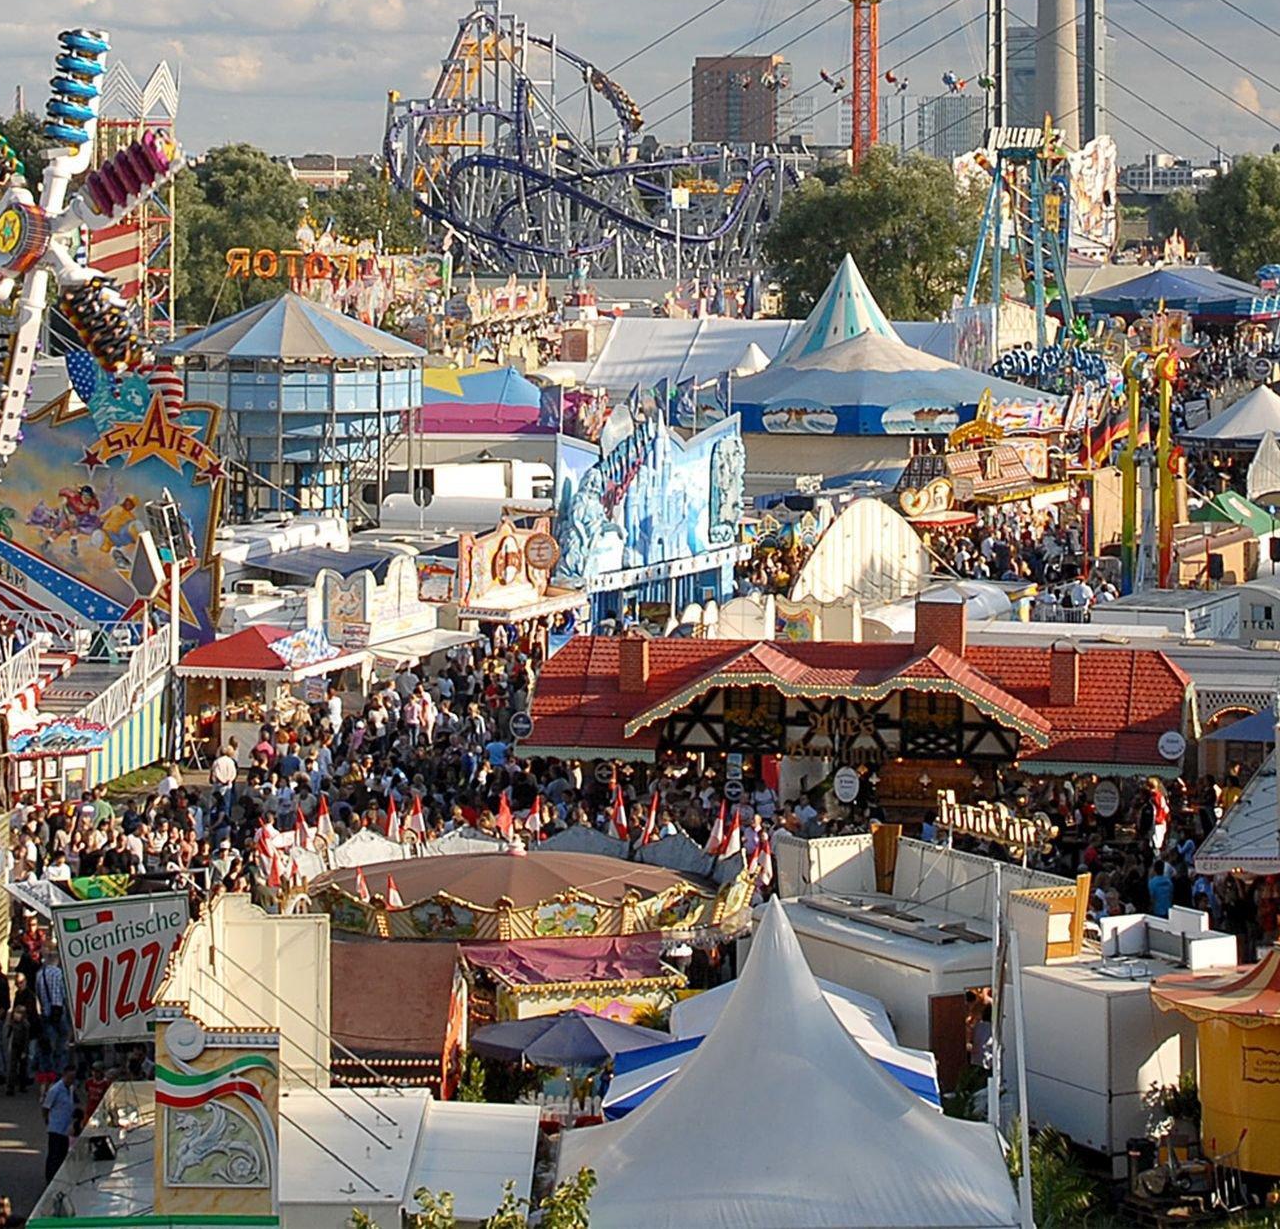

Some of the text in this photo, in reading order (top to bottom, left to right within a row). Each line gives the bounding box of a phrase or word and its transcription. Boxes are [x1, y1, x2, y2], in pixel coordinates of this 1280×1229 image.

[104, 399, 204, 461] SKATER
[68, 911, 181, 959] Ofenfrische
[74, 934, 183, 1030] PIZZ
